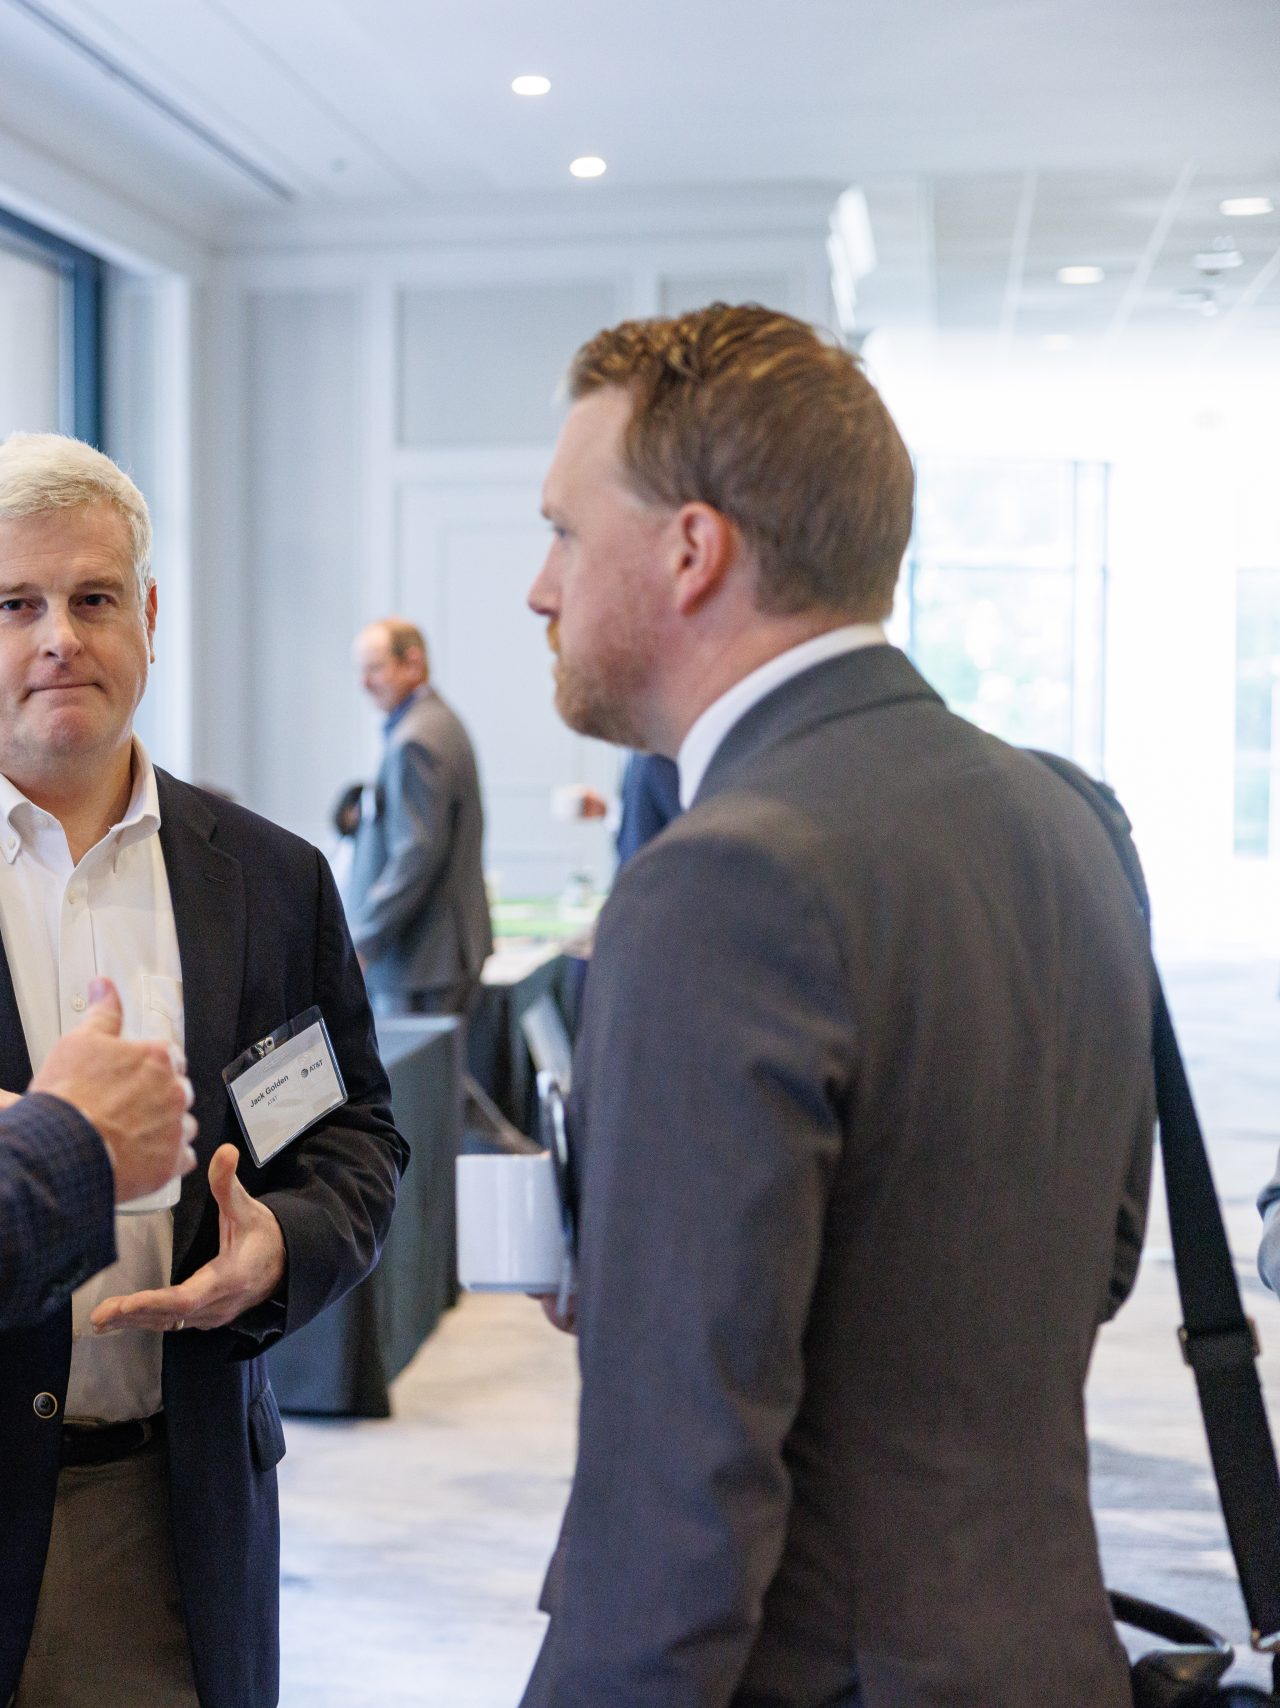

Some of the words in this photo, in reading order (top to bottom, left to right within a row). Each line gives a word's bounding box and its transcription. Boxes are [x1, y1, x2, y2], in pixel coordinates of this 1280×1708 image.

[309, 1059, 323, 1073] AT&T
[250, 1092, 265, 1108] Jack
[265, 1075, 289, 1095] Golden
[267, 1095, 278, 1107] AT&T
